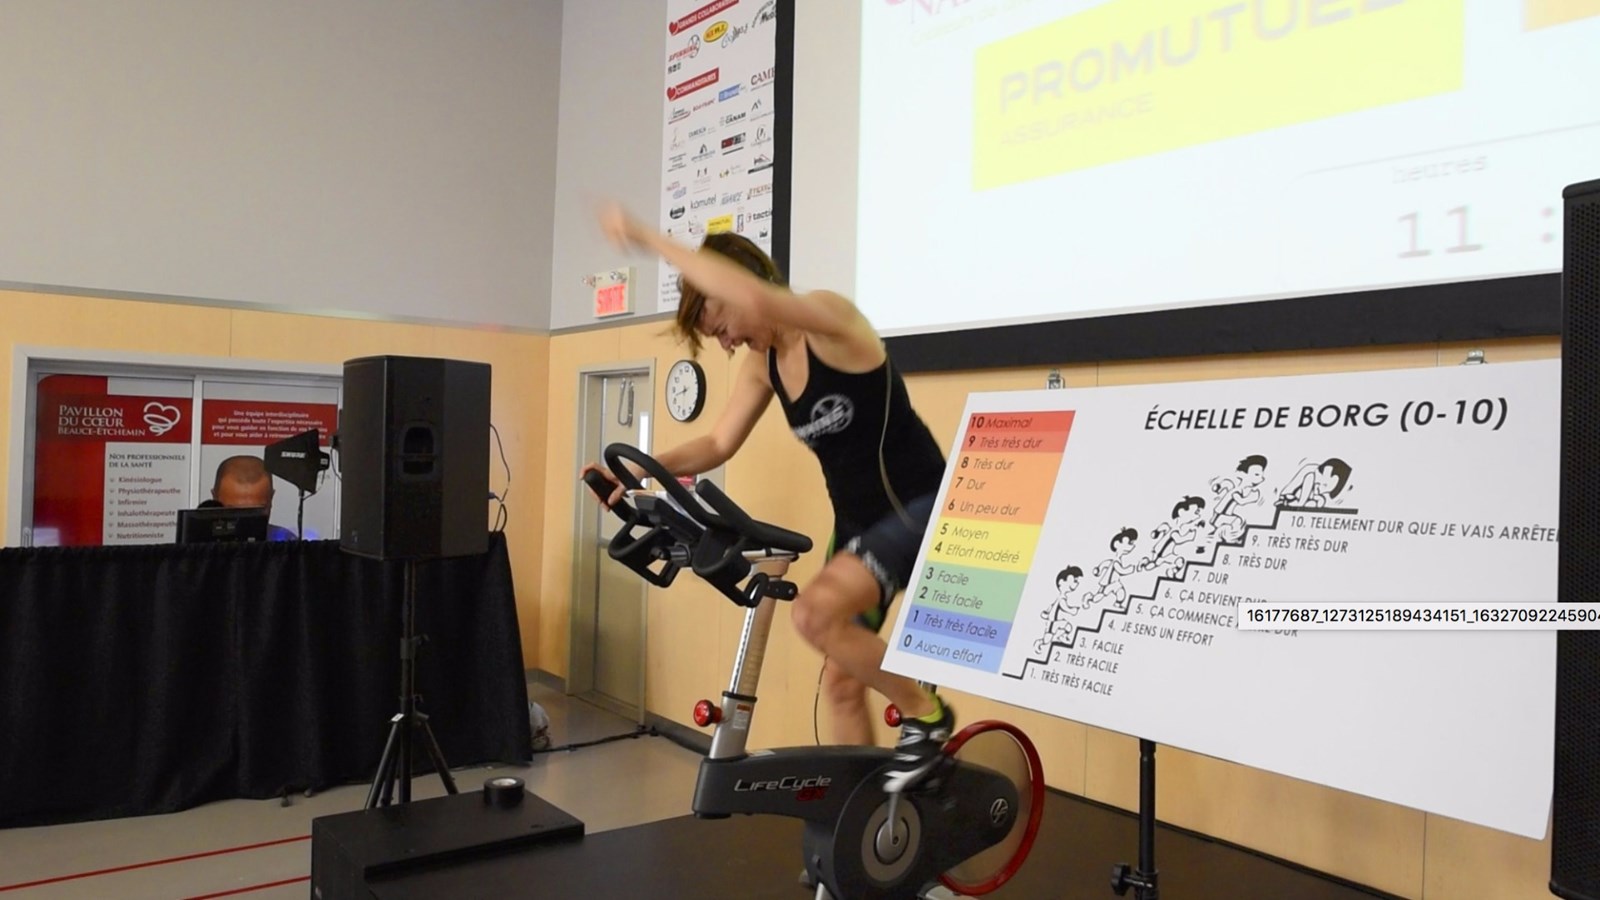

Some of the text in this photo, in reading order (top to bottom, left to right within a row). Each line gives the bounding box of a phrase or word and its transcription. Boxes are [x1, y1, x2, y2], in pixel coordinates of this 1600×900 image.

[999, 0, 1409, 114] PROMUTUE
[1000, 92, 1155, 147] ASSURANCE
[1391, 155, 1488, 185] heures
[1397, 202, 1487, 258] 11
[59, 405, 123, 417] PAVILLON
[1144, 398, 1508, 432] ÉCHELLE DE BORG (0-10)
[59, 417, 125, 428] DU CŒUR
[971, 416, 1032, 428] 10 Maximal
[969, 436, 1042, 448] 9 Très très dur
[961, 456, 1014, 470] 8 Très dur
[955, 477, 986, 490] 7 Dur
[948, 499, 1020, 516] 6 Un peu dur
[940, 523, 989, 540] 5 Moyen
[1291, 516, 1306, 528] 10.
[1310, 517, 1374, 531] TELLEMENT
[1378, 520, 1404, 534] DUR
[1408, 522, 1437, 535] QUE
[1440, 523, 1456, 536] JE
[1462, 524, 1495, 539] VAIS
[935, 542, 1020, 563] 4 Effort modéré
[1252, 533, 1348, 553] 9. TRÈS TRÈS DUR
[1222, 553, 1288, 570] 8. TRÈS DUR
[926, 567, 969, 586] 3 Facile
[1192, 570, 1229, 585] 7. DUR
[919, 586, 983, 609] 2 Très facile
[1164, 588, 1172, 599] 6.
[1179, 589, 1194, 603] ÇA
[913, 610, 997, 639] 1 Très très facile
[1136, 603, 1143, 614] 5.
[1150, 605, 1165, 618] ÇA
[1168, 608, 1233, 627] COMMENCE
[1108, 619, 1214, 646] 4. JE SENS UN EFFORT
[904, 635, 983, 664] 0 Aucun effort
[1080, 637, 1124, 655] 3. FACILE
[1054, 651, 1118, 674] 2. TRÈS FACILE
[1030, 668, 1113, 696] 1. TRÈS TRÈS FACILE
